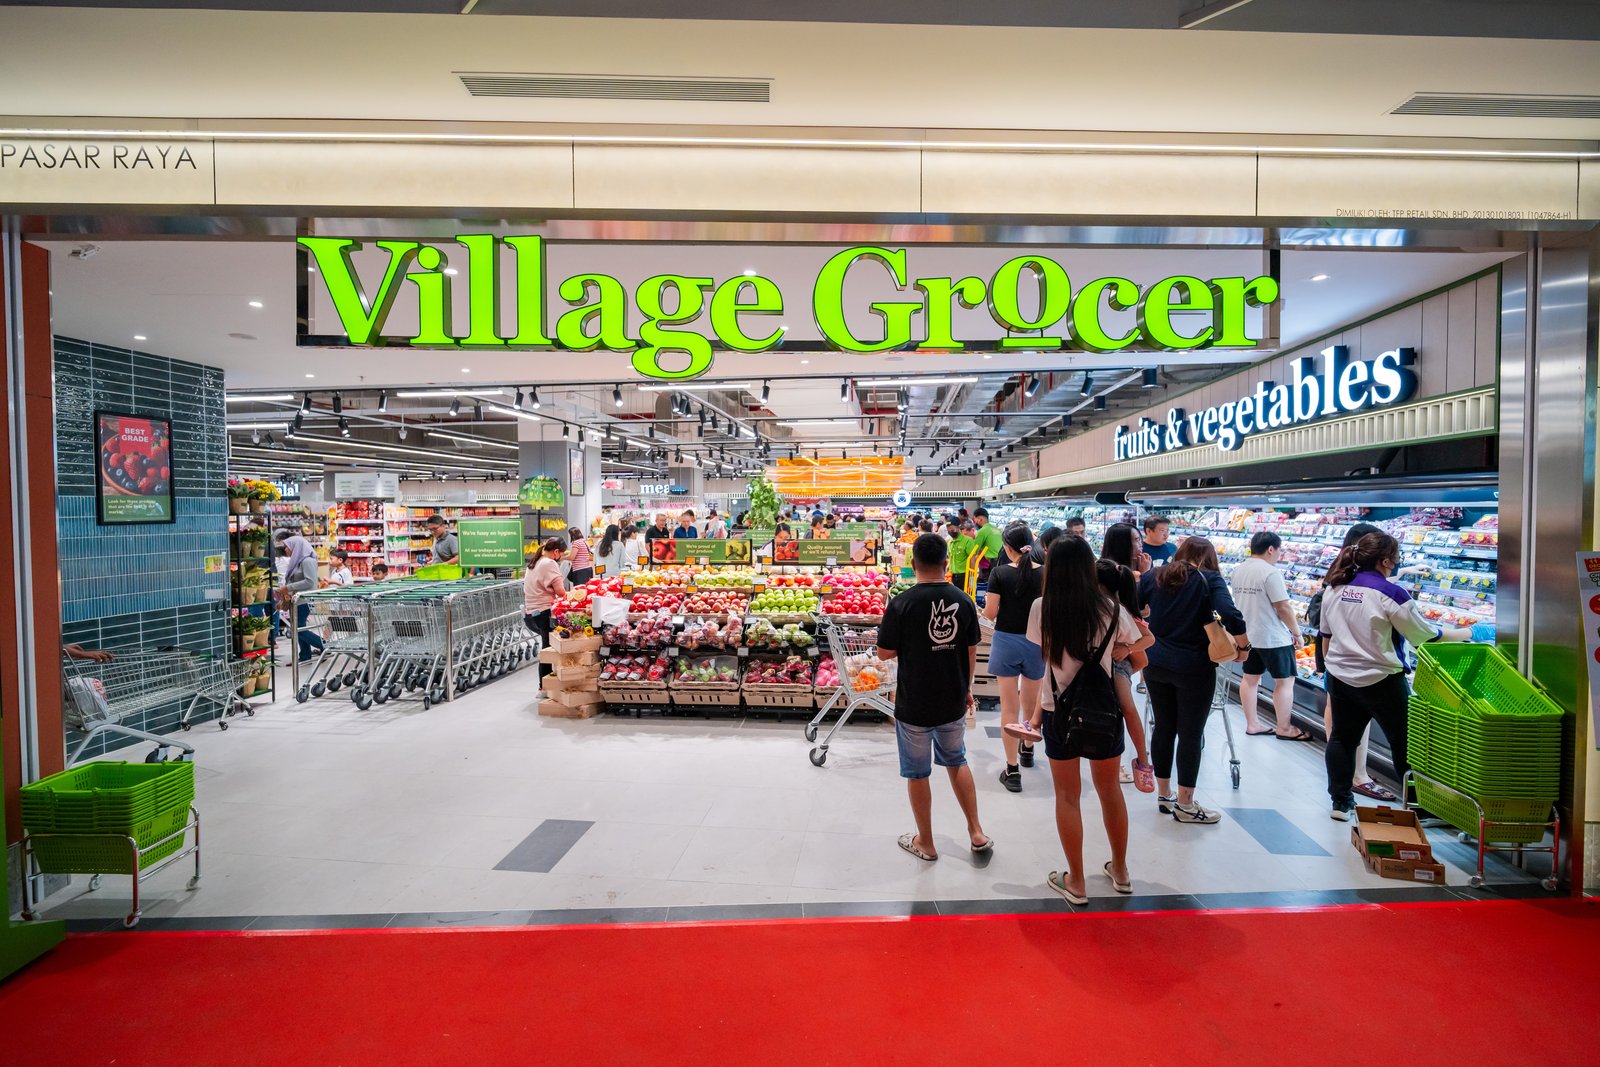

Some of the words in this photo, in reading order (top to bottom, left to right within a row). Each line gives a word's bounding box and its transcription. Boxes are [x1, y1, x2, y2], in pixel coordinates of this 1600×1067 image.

[1, 144, 101, 169] PASAR
[113, 145, 197, 169] RAYA
[297, 234, 784, 379] Village
[812, 246, 1280, 352] Grocer
[1113, 418, 1160, 461] fruits
[1164, 407, 1184, 450] &
[1188, 345, 1405, 452] vegetables
[125, 427, 146, 435] BEST
[121, 435, 149, 443] GRADE
[640, 483, 670, 494] mea
[1341, 588, 1364, 599] bites
